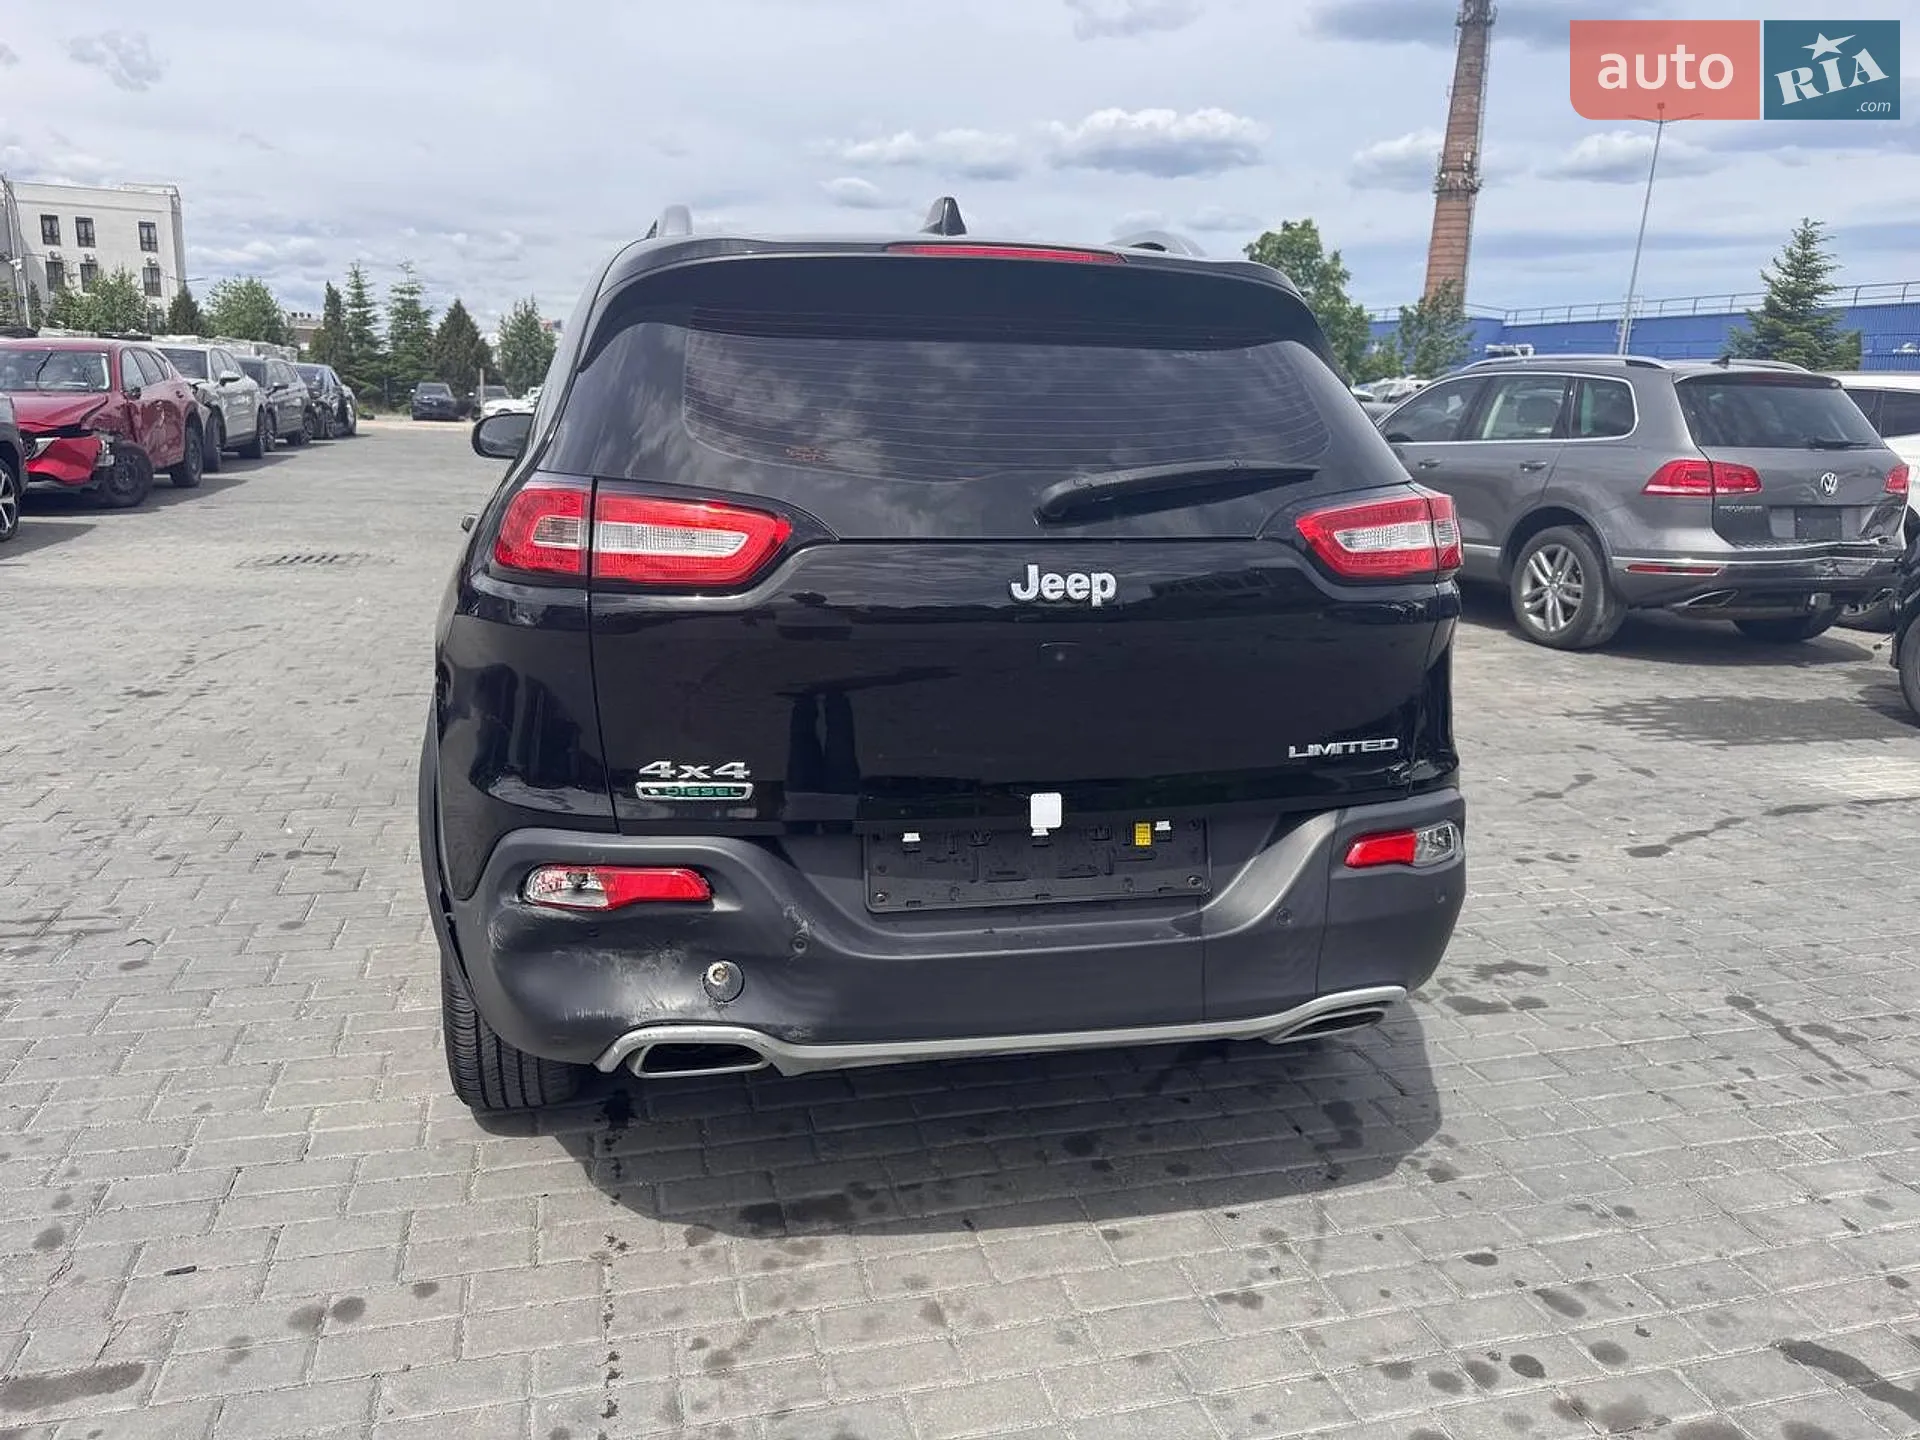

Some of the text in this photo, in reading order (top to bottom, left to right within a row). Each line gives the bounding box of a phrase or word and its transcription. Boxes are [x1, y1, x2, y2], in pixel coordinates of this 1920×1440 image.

[1010, 564, 1117, 607] Jeep
[1288, 738, 1399, 759] LIMITED
[639, 760, 751, 779] 4x4
[664, 786, 743, 797] DIESEL
